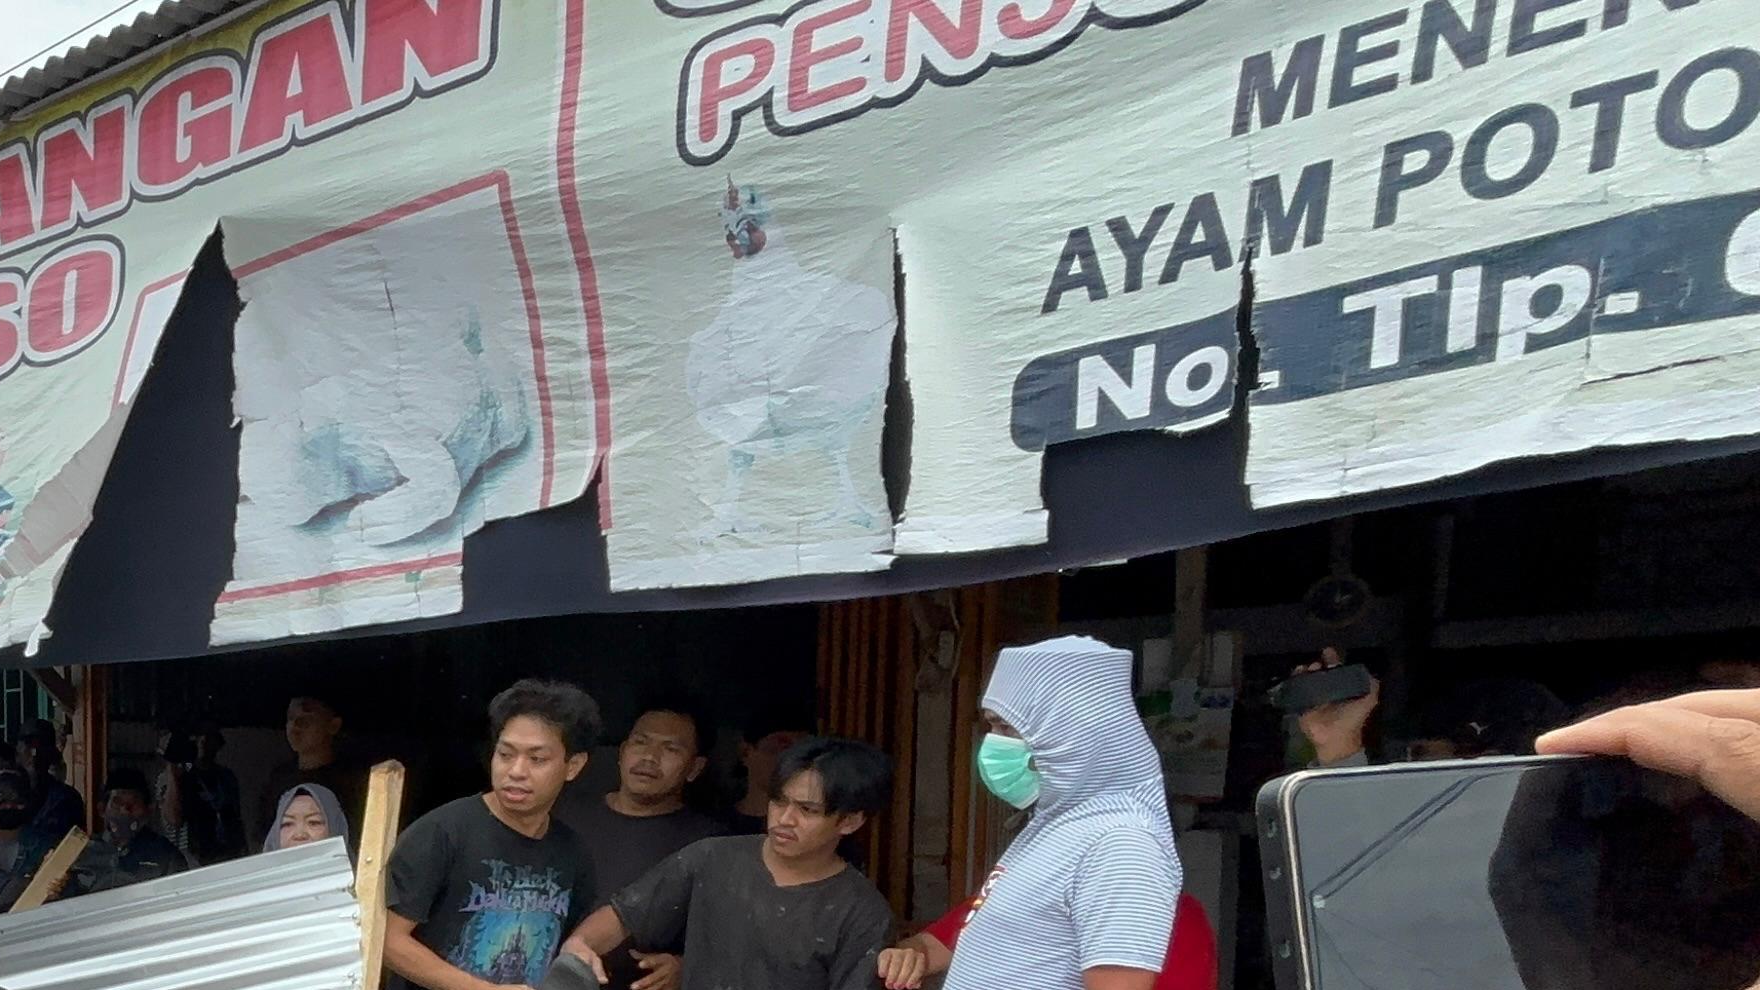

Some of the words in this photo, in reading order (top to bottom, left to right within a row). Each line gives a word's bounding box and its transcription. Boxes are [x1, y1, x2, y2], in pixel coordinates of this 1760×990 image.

[1041, 159, 1334, 315] AYAM
[1373, 46, 1760, 230] POTO
[1075, 344, 1281, 431] No.
[1342, 264, 1640, 371] Tlp.
